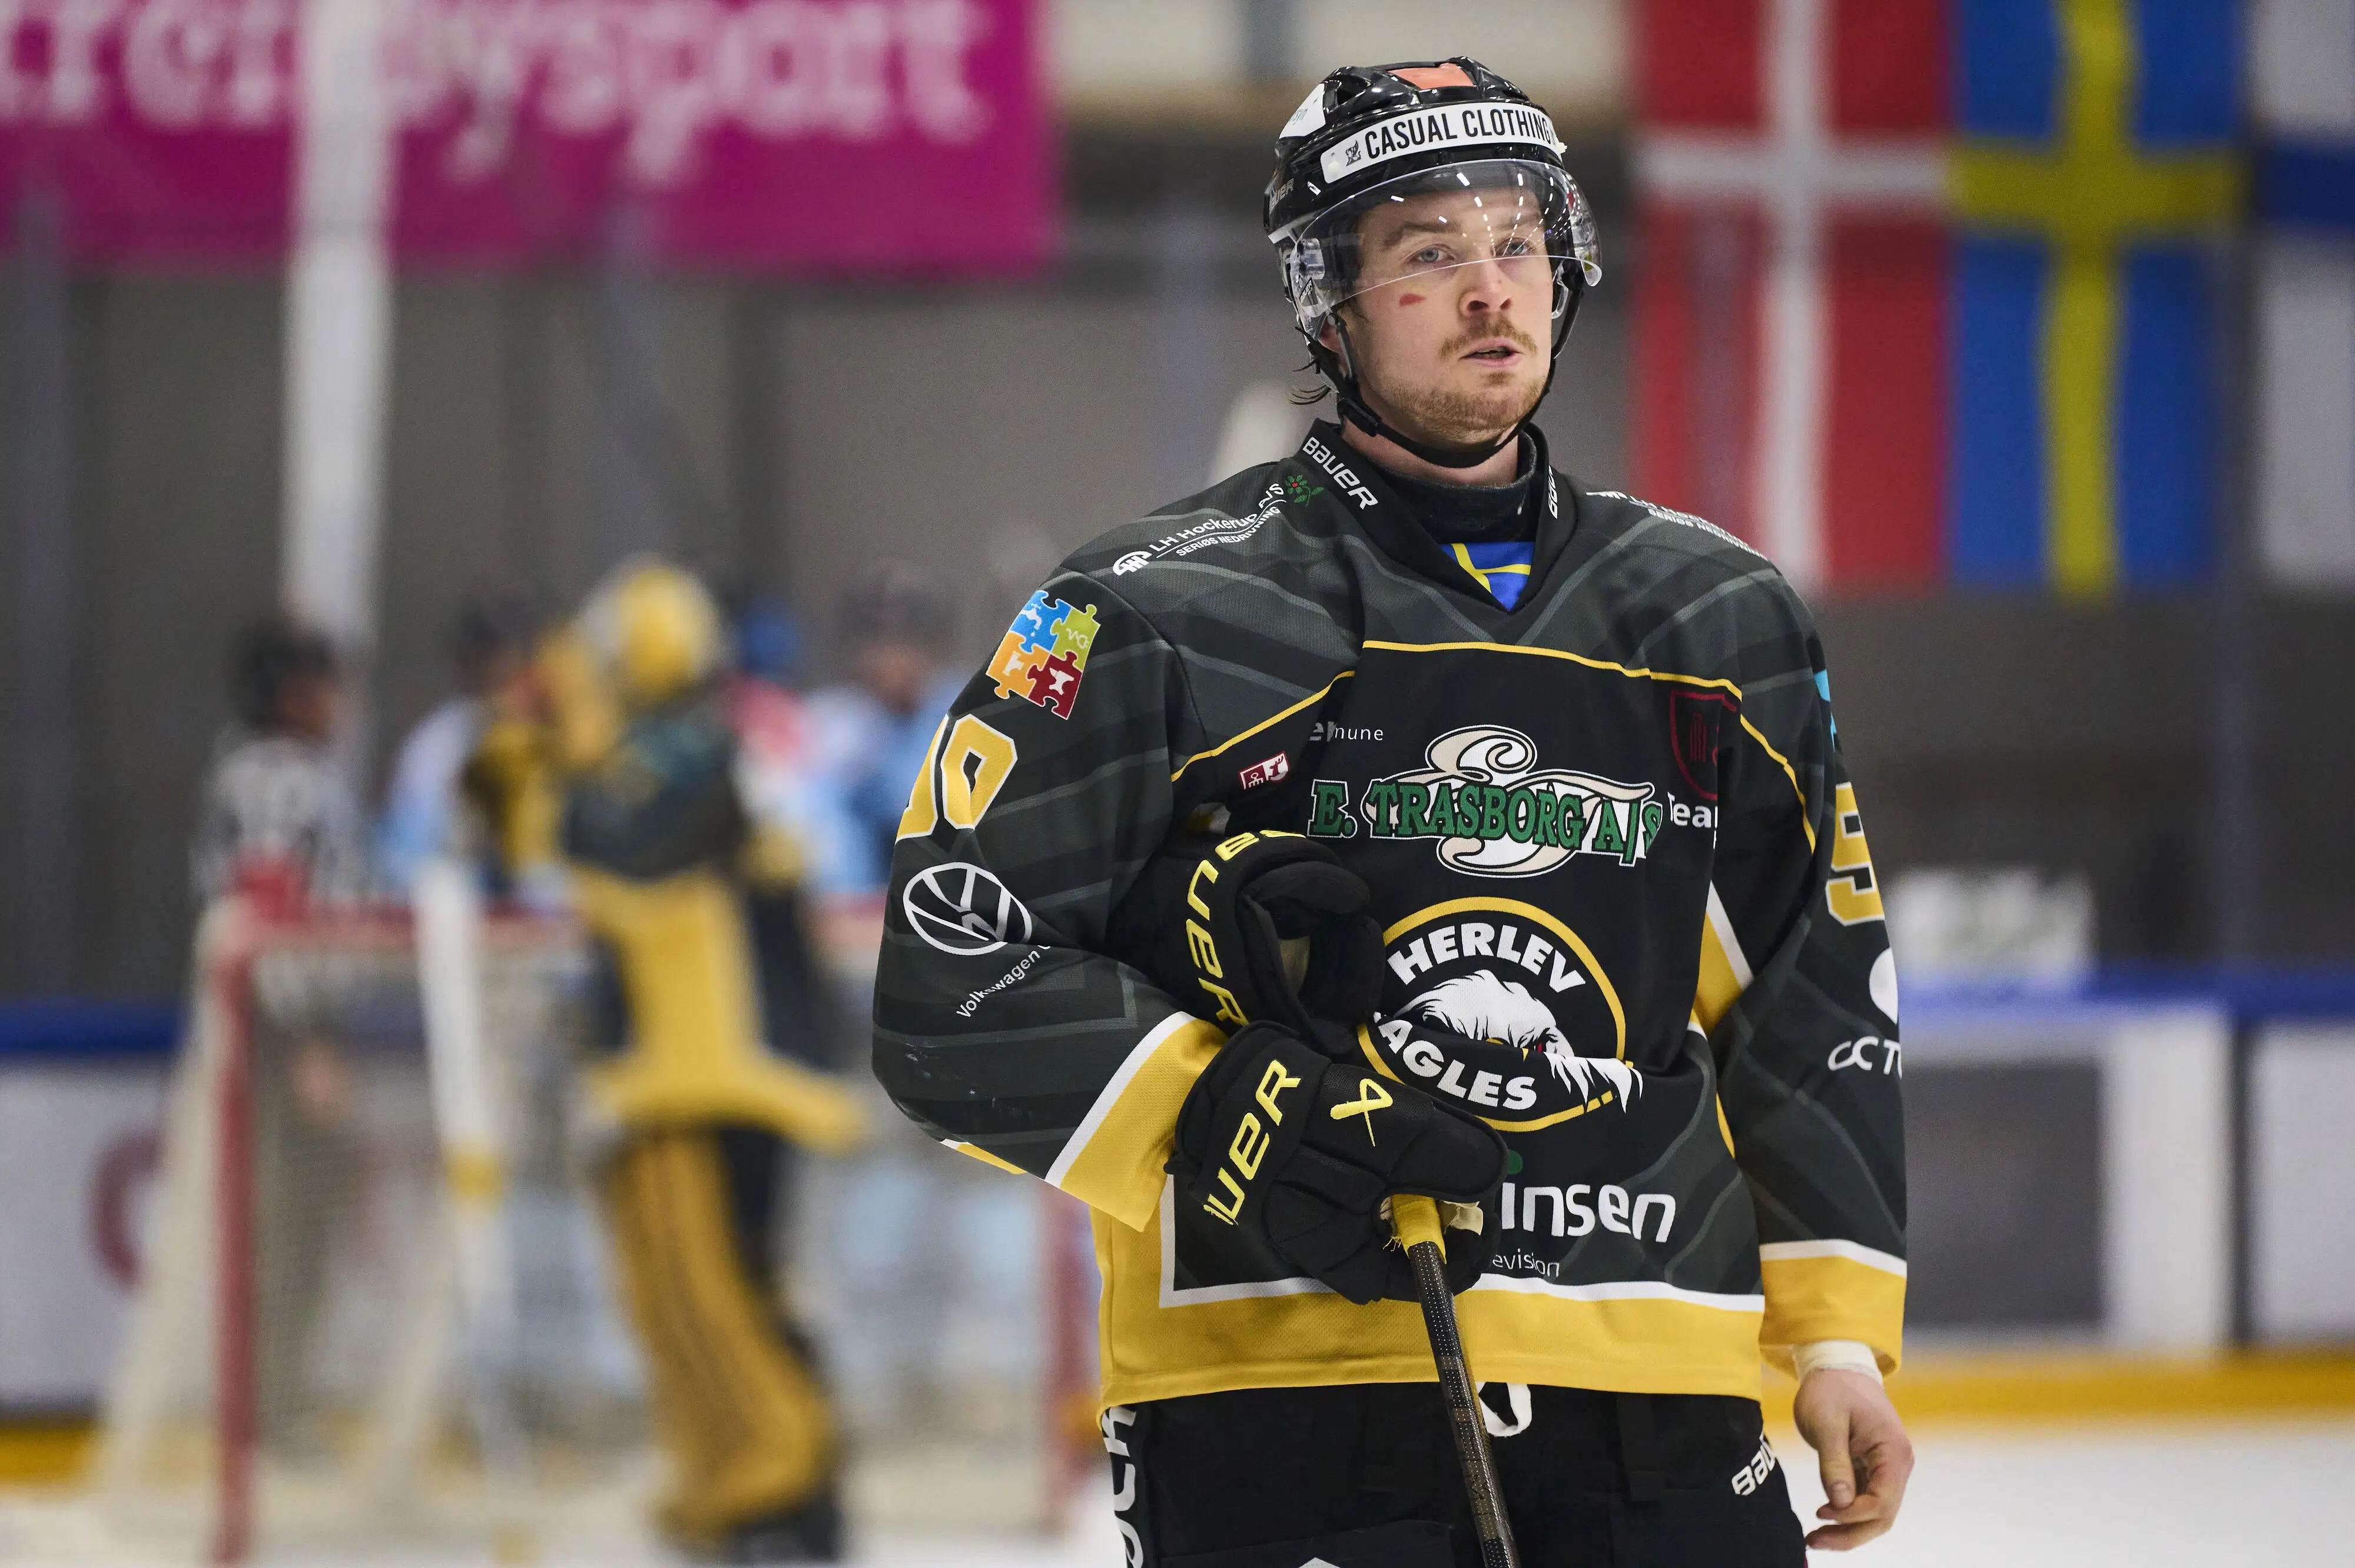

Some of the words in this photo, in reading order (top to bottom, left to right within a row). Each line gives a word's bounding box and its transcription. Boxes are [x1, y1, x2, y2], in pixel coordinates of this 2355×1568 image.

[1365, 114, 1458, 159] CASUAL
[1462, 108, 1551, 145] CLOTHING
[1149, 537, 1179, 552] LH
[1176, 513, 1258, 540] Hockerup
[1258, 483, 1283, 509] A/S
[1176, 537, 1218, 556] SERIØS
[1218, 506, 1281, 543] NEDRIVNING
[1368, 782, 1587, 849] TRASBORG
[956, 950, 1041, 1018] Volkswagen
[1387, 922, 1586, 994] HERLEV
[1374, 1011, 1537, 1111] AGLES
